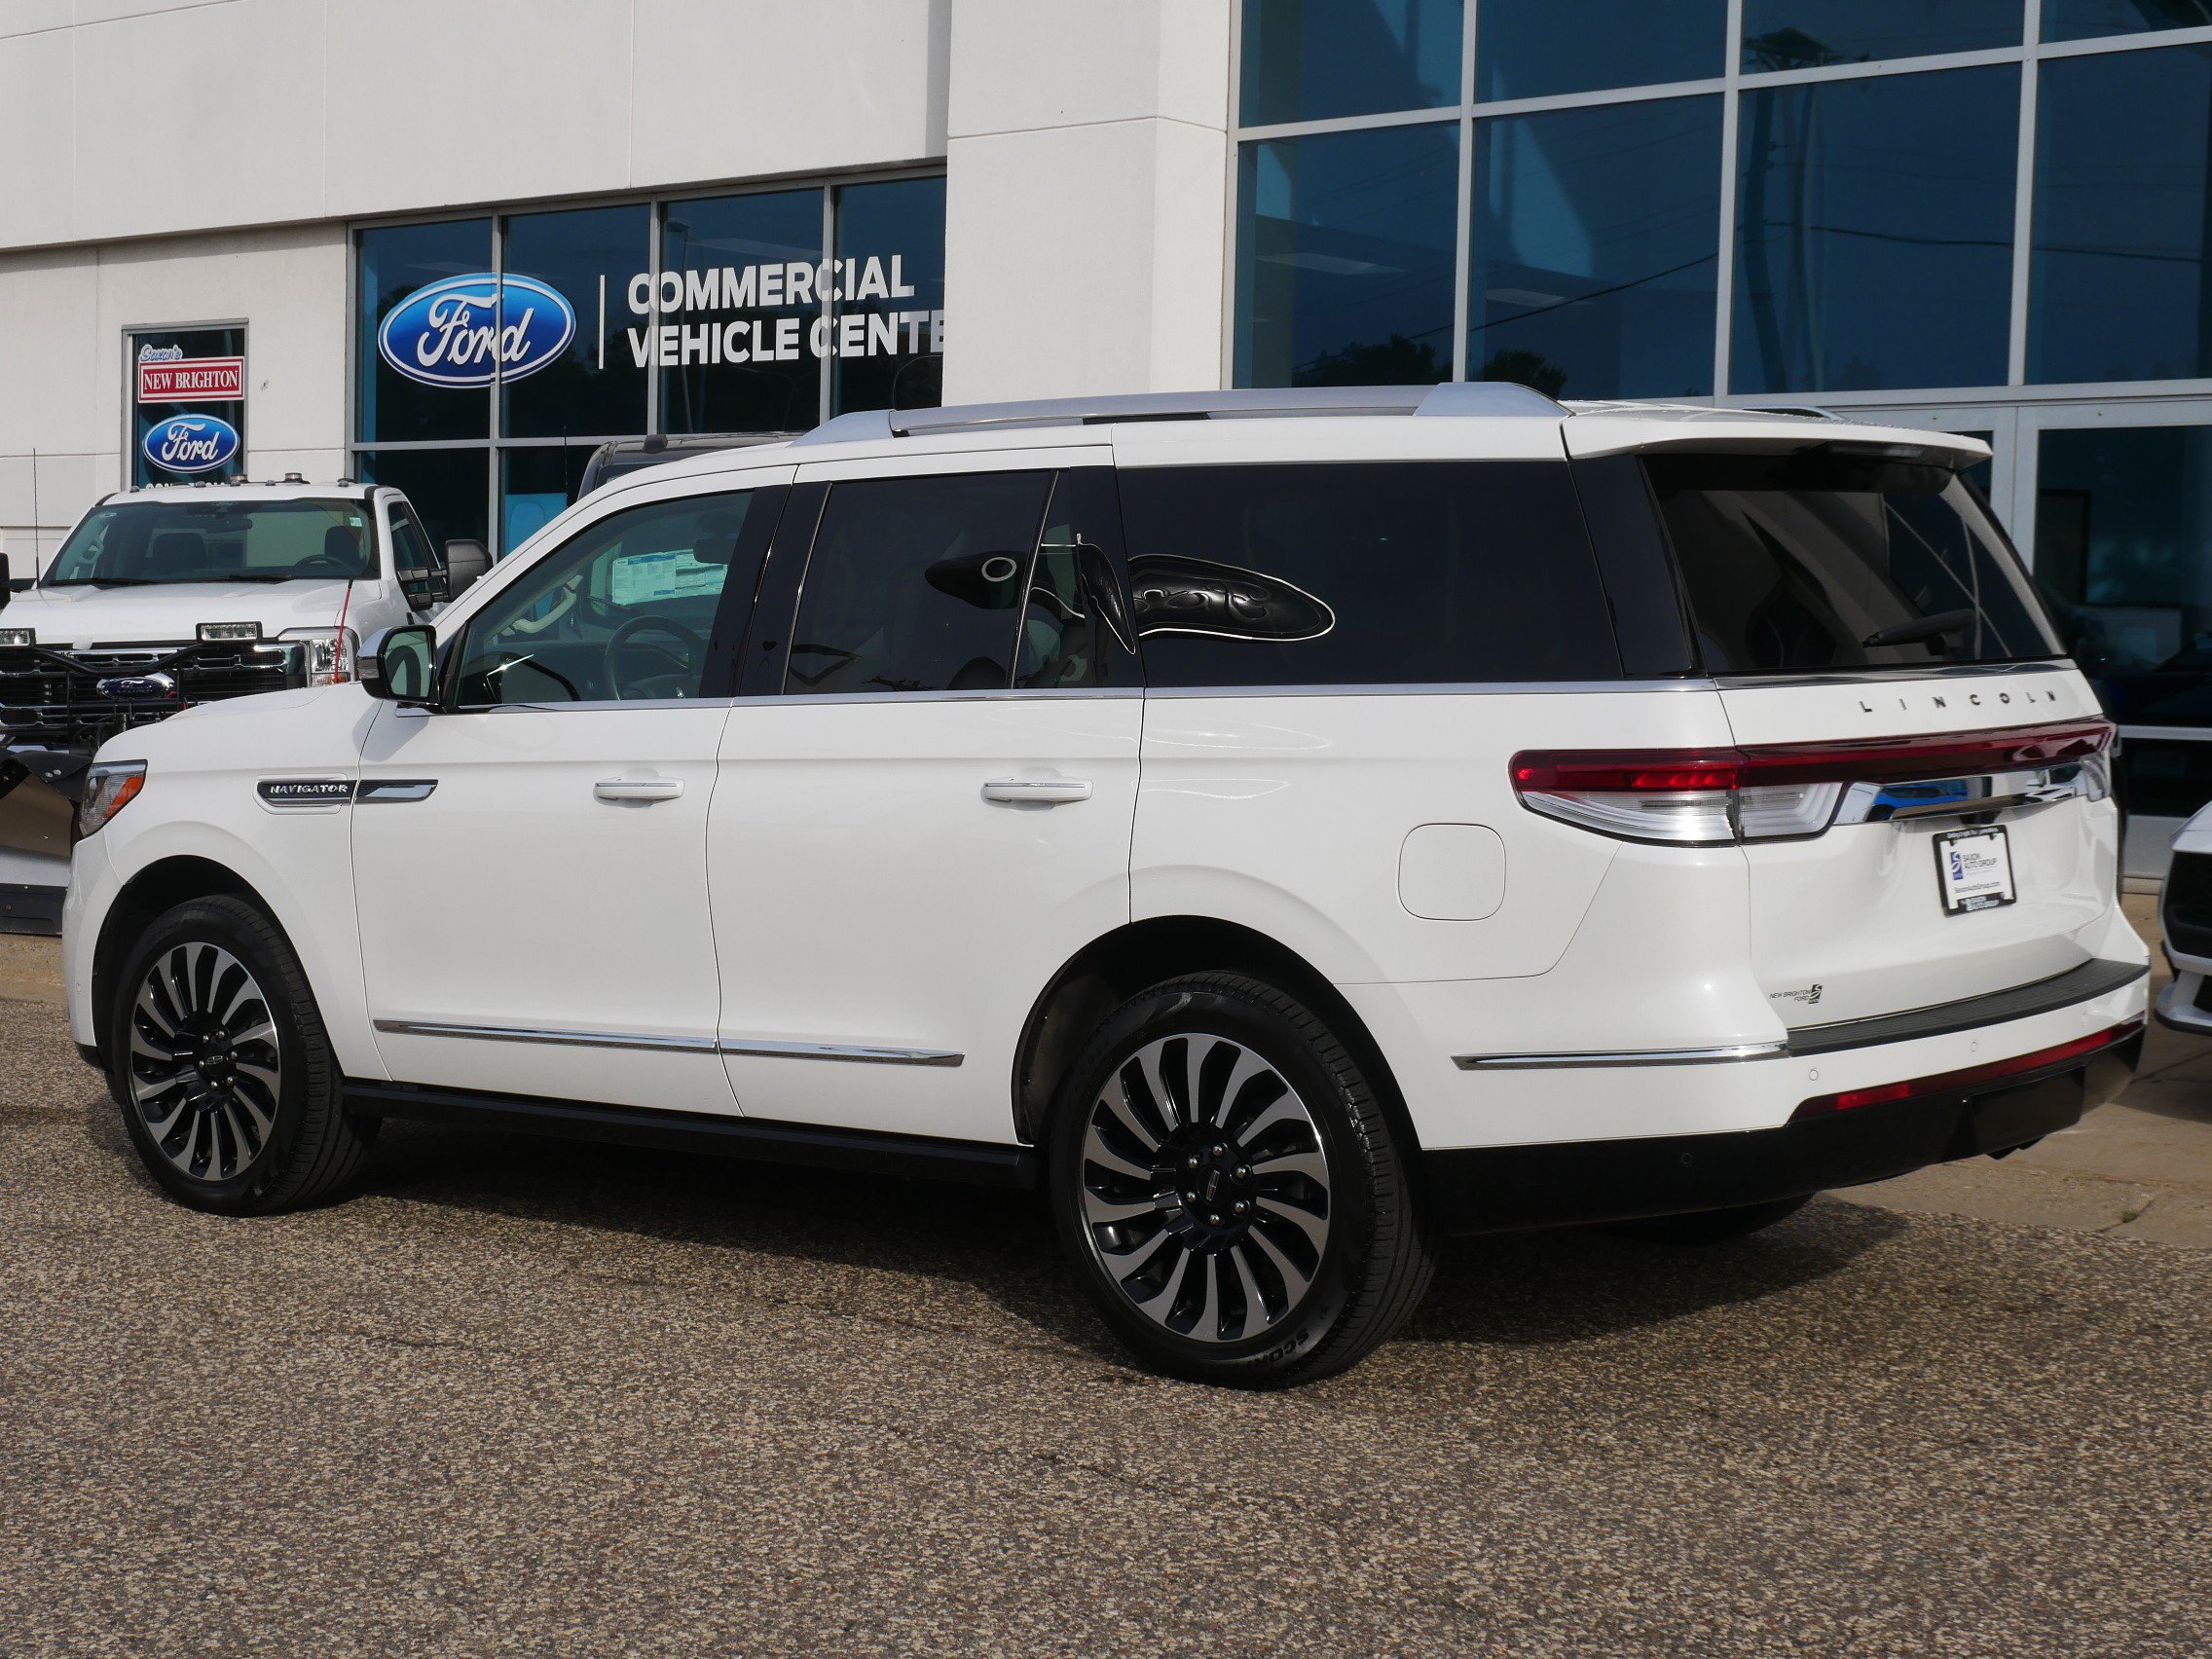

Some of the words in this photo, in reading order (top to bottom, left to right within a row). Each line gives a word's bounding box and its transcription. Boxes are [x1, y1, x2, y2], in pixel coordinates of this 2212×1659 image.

[627, 254, 915, 314] COMMERCIAL
[417, 293, 534, 367] Ford
[627, 316, 800, 368] VEHICLE
[809, 310, 944, 360] CENTE
[139, 345, 182, 362] Saxon's
[144, 372, 172, 390] NEW
[175, 370, 239, 389] BRIGHTON
[161, 422, 220, 461] Ford
[1859, 690, 2057, 713] LINCOLN
[270, 784, 349, 794] NAVIGATOR
[1978, 858, 1997, 867] GROUP
[1783, 989, 1812, 998] BRIGHTON
